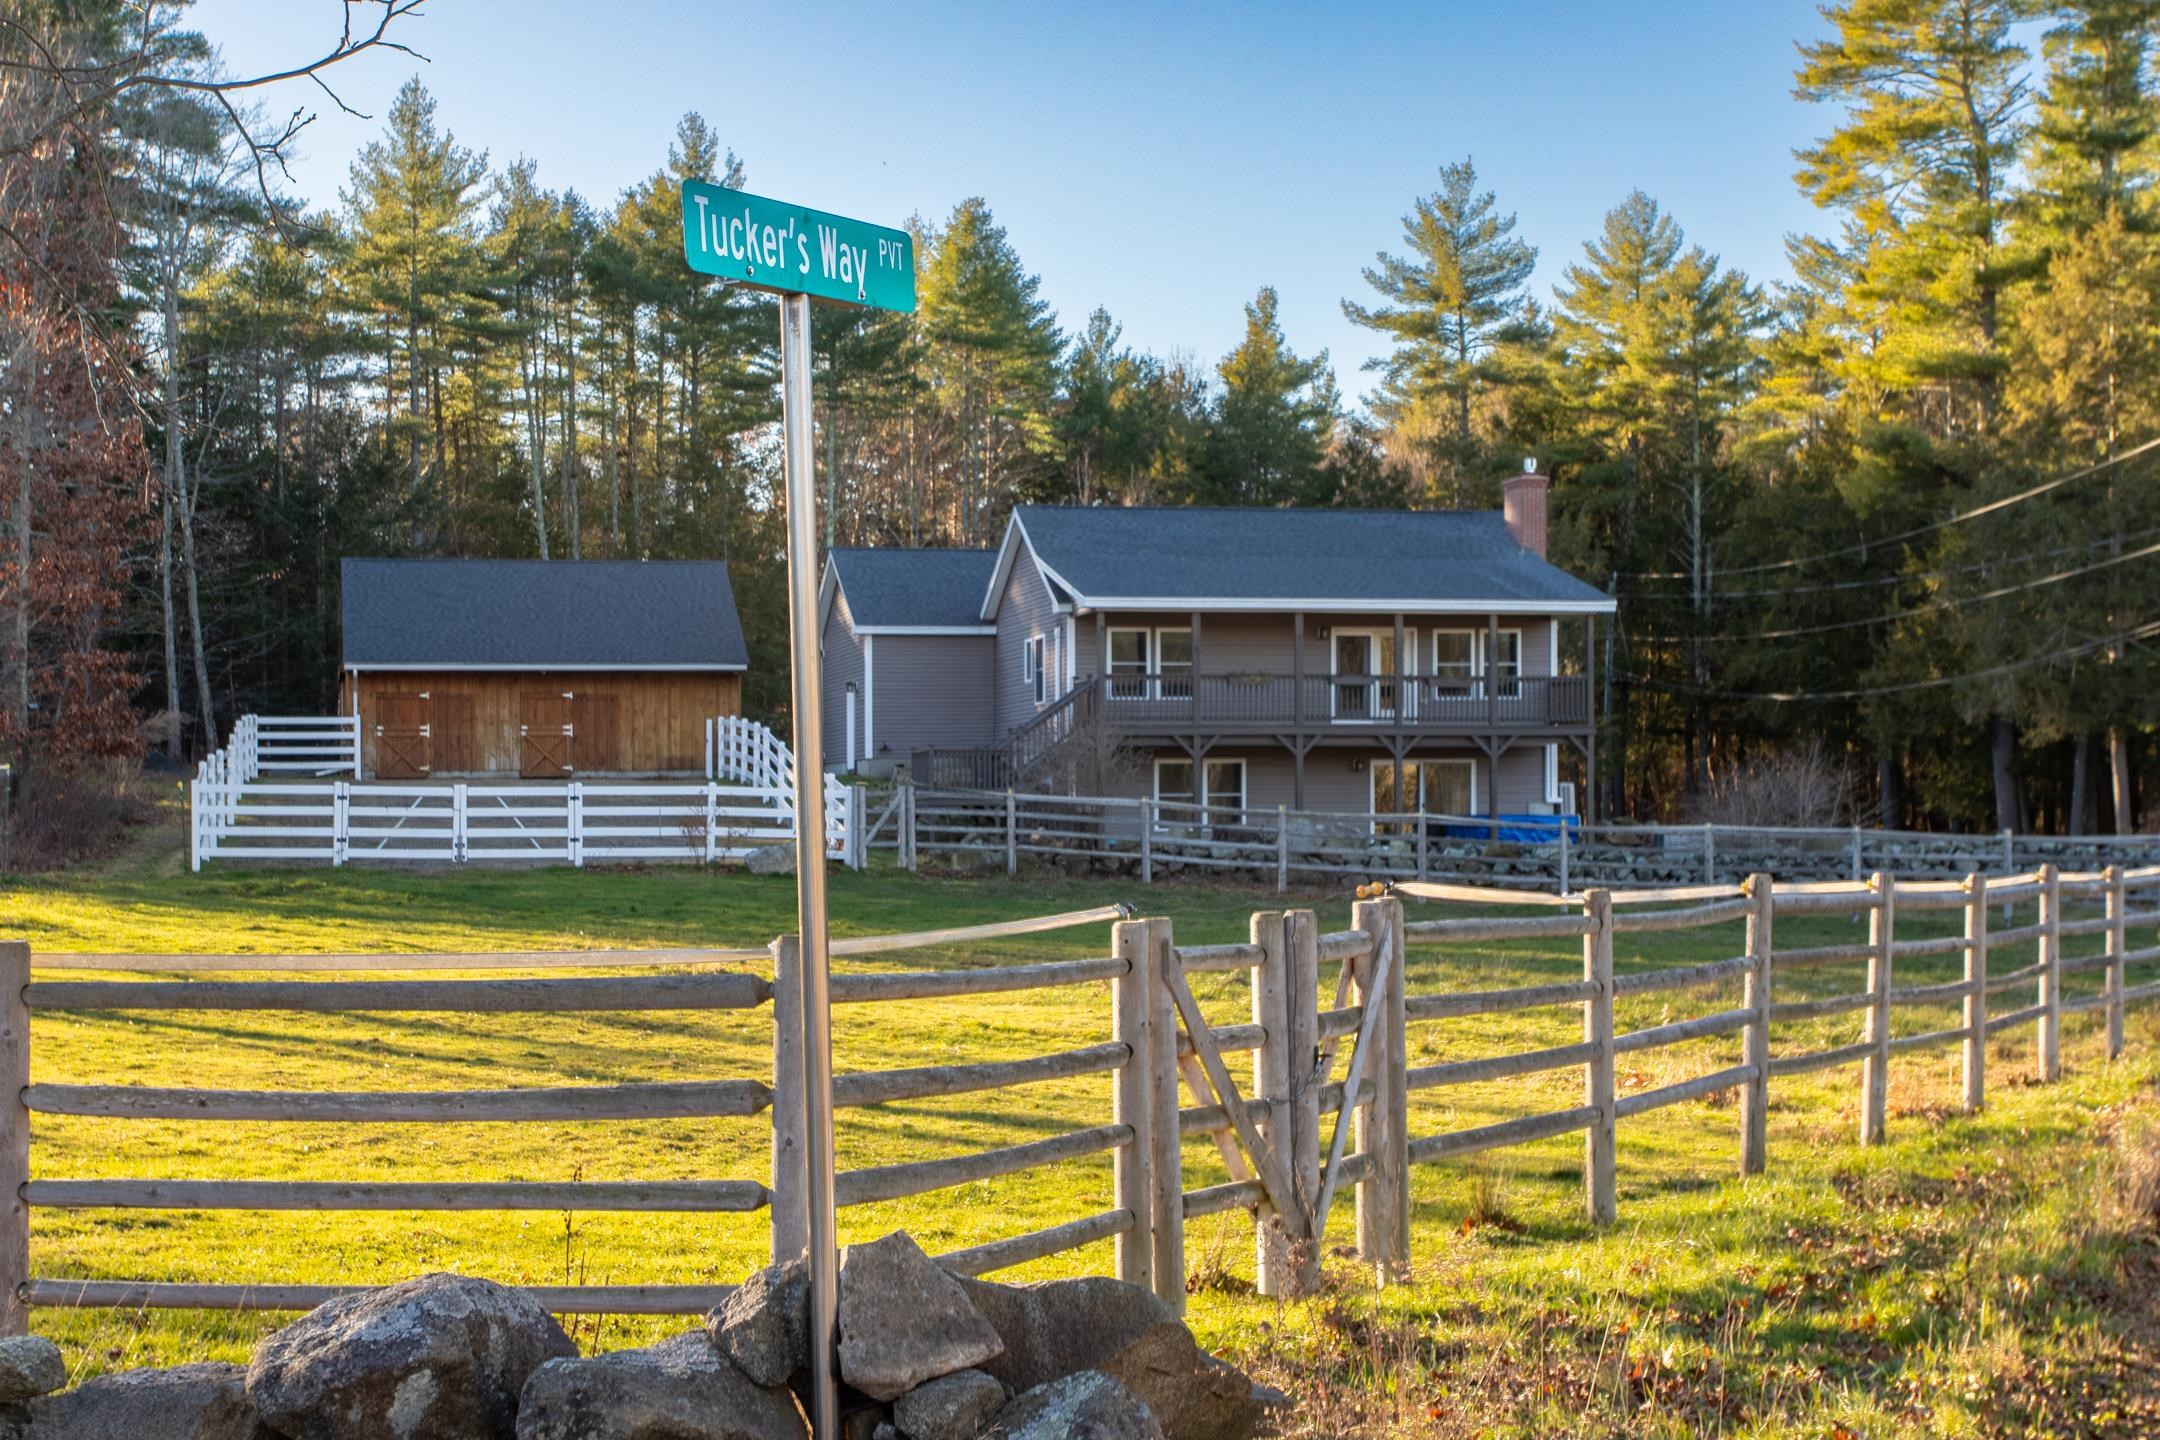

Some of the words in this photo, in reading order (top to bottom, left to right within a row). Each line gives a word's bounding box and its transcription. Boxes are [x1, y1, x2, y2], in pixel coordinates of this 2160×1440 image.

[694, 194, 810, 275] Tucker's
[817, 224, 867, 298] Way
[878, 238, 903, 271] PVT
